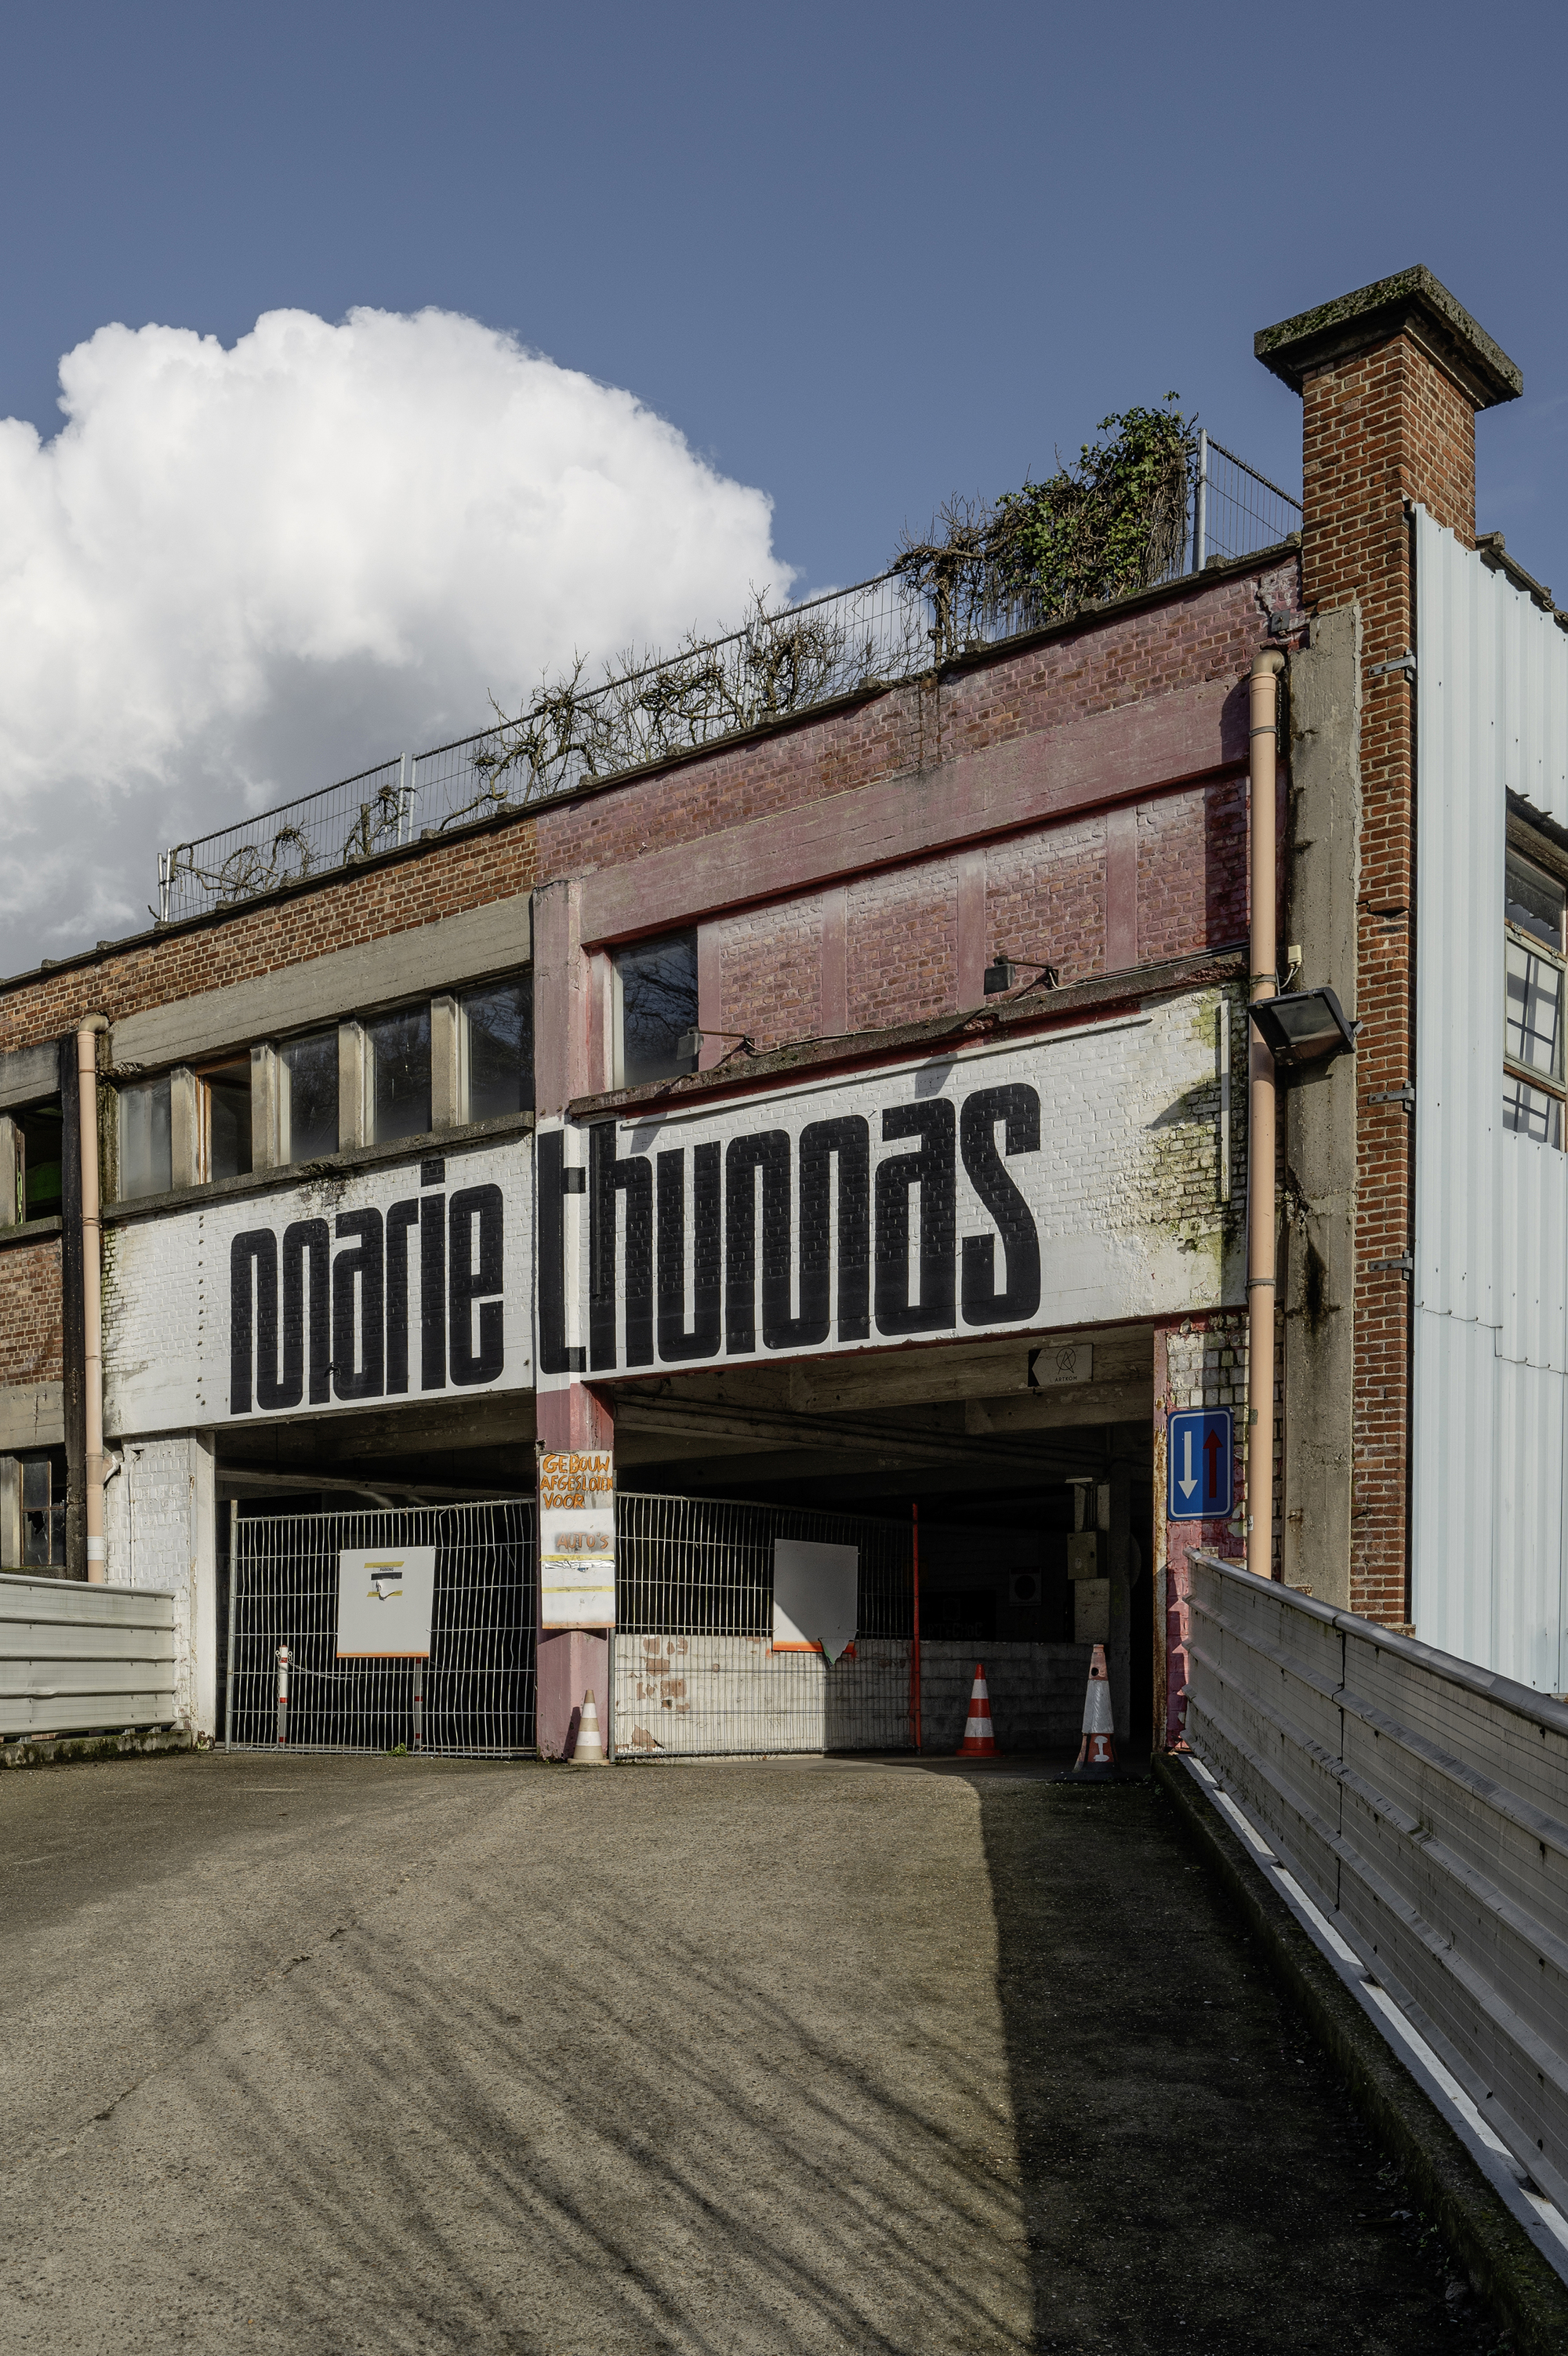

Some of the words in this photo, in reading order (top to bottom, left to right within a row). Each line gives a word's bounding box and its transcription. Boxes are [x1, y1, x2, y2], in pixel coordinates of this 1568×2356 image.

[230, 1158, 503, 1414] marie
[537, 1083, 1041, 1374] thumas
[543, 1454, 610, 1474] GEBOUW
[539, 1475, 613, 1491] AFGESLOTEN
[543, 1493, 585, 1509] VOOR
[557, 1533, 609, 1549] AUTO'S
